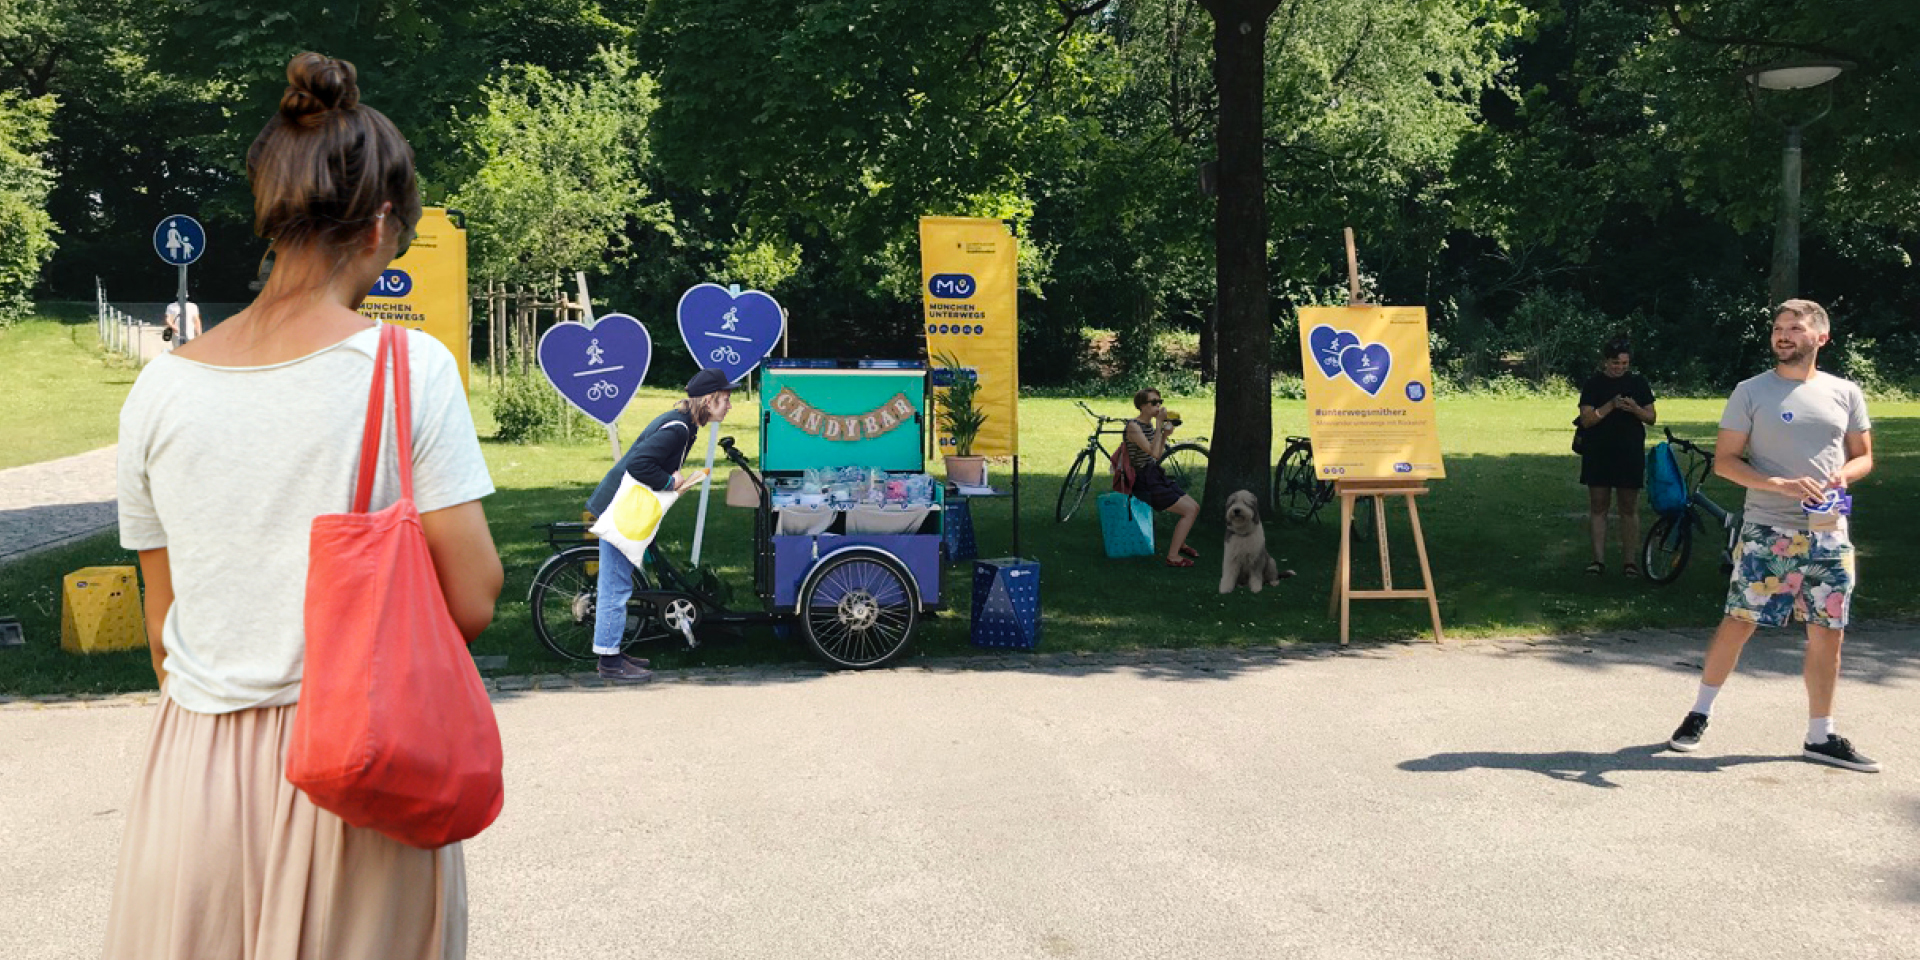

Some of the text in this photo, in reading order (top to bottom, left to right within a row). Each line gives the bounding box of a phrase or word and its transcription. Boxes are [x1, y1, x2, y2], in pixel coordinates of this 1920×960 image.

[361, 312, 425, 320] NTERWEGS
[929, 311, 986, 319] UNTERWEGS
[1315, 408, 1406, 417] #unterwegsmitherz
